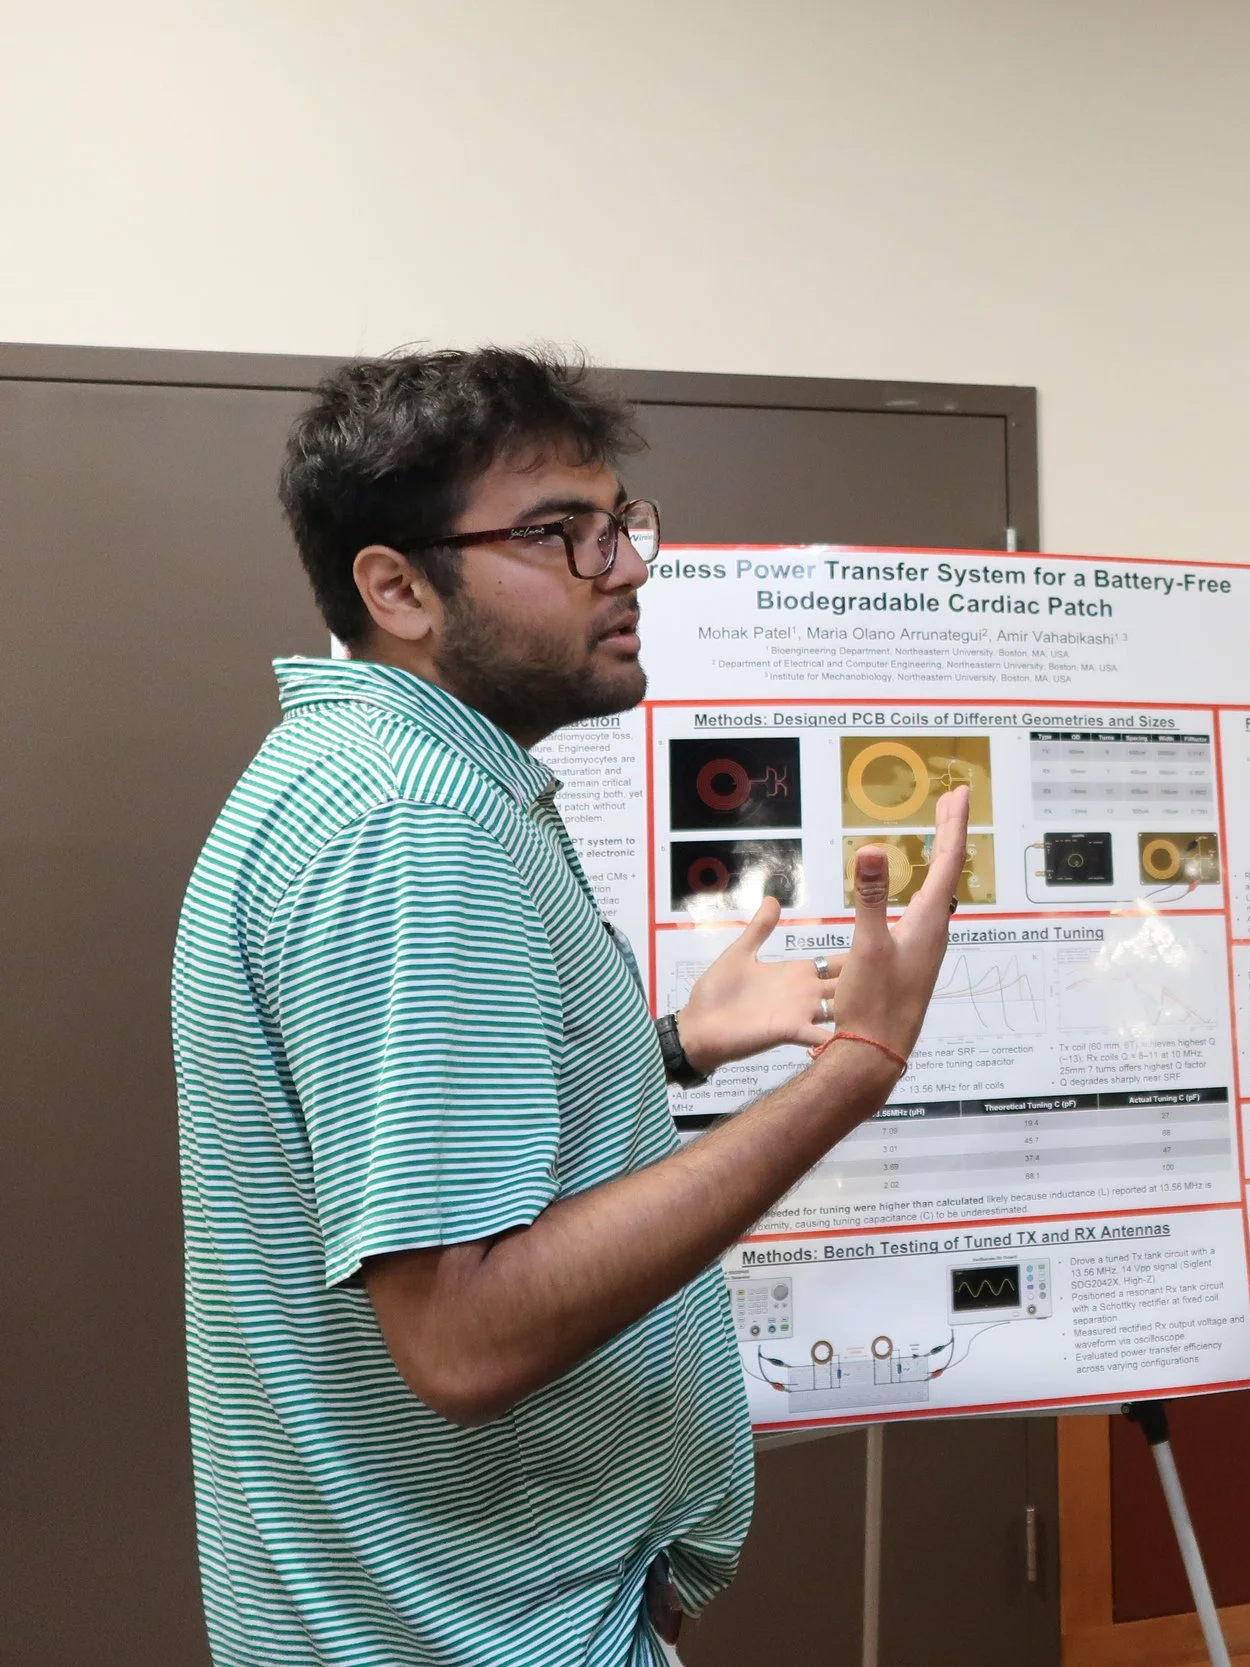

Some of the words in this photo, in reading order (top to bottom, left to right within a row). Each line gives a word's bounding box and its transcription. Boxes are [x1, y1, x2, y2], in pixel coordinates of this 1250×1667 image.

[648, 558, 728, 579] reless
[735, 559, 816, 580] Power
[824, 560, 931, 580] Transfer
[936, 565, 1026, 588] System
[1032, 568, 1067, 586] for
[1072, 572, 1086, 587] a
[1093, 569, 1232, 593] Battery-Free
[756, 589, 940, 616] Biodegradable
[947, 593, 1040, 614] Cardiac
[1047, 596, 1112, 617] Patch
[698, 626, 748, 639] Mohak
[806, 626, 847, 639] Maria
[852, 626, 895, 640] Olano
[997, 629, 1028, 641] Amir
[770, 646, 837, 656] Bioengineering
[894, 647, 950, 655] Northeastern
[1049, 649, 1070, 658] USA
[717, 659, 771, 668] Department
[771, 659, 783, 667] of
[782, 659, 825, 667] Electrical
[844, 659, 889, 668] Computer
[945, 660, 1002, 669] Northeastern
[768, 672, 806, 680] Institute
[806, 672, 820, 680] for
[896, 673, 953, 681] Northeastern
[693, 713, 767, 726] Methods:
[772, 713, 847, 727] Designed
[851, 713, 886, 727] PCB
[889, 713, 929, 727] Coils
[933, 713, 949, 728] of
[952, 714, 1018, 728] Different
[1021, 714, 1104, 728] Geometries
[1108, 715, 1134, 728] and
[1138, 714, 1175, 727] Sizes
[555, 790, 601, 802] ddressing
[586, 837, 623, 847] system
[585, 848, 635, 857] electronic
[947, 928, 1017, 943] terization
[1020, 927, 1049, 943] and
[1052, 925, 1104, 942] Tuning
[784, 933, 850, 949] Results:
[934, 1048, 955, 1058] near
[957, 1047, 976, 1056] SRF
[991, 1045, 1034, 1055] correction
[915, 1060, 944, 1071] before
[945, 1059, 974, 1070] tuning
[973, 1057, 1015, 1067] capacitor
[714, 1075, 759, 1088] geometry
[934, 1082, 957, 1092] MHz
[957, 1081, 971, 1091] for
[972, 1081, 983, 1090] all
[984, 1081, 1005, 1090] coils
[713, 1090, 743, 1098] remain
[1128, 1096, 1152, 1104] Actual
[1152, 1093, 1178, 1105] Tuning
[1185, 1092, 1200, 1104] (pF)
[671, 1103, 694, 1112] MHz
[983, 1101, 1026, 1114] Theoretical
[1026, 1100, 1053, 1113] Tuning
[1061, 1099, 1077, 1112] (pF)
[801, 1206, 818, 1216] for
[818, 1205, 852, 1216] tuning
[851, 1204, 877, 1212] were
[877, 1200, 911, 1212] higher
[911, 1199, 935, 1208] than
[934, 1195, 985, 1207] calculated
[1009, 1192, 1048, 1202] because
[1048, 1188, 1096, 1199] inductance
[1110, 1185, 1148, 1195] reported
[794, 1219, 830, 1233] causing
[863, 1213, 917, 1229] capacitance
[741, 1246, 817, 1264] Methods:
[823, 1242, 874, 1259] Bench
[880, 1238, 939, 1256] Testing
[943, 1236, 959, 1250] of
[964, 1233, 1012, 1250] Tuned
[1018, 1231, 1037, 1247] TX
[1041, 1229, 1069, 1246] and
[1074, 1227, 1096, 1244] RX
[1099, 1223, 1170, 1242] Antennas
